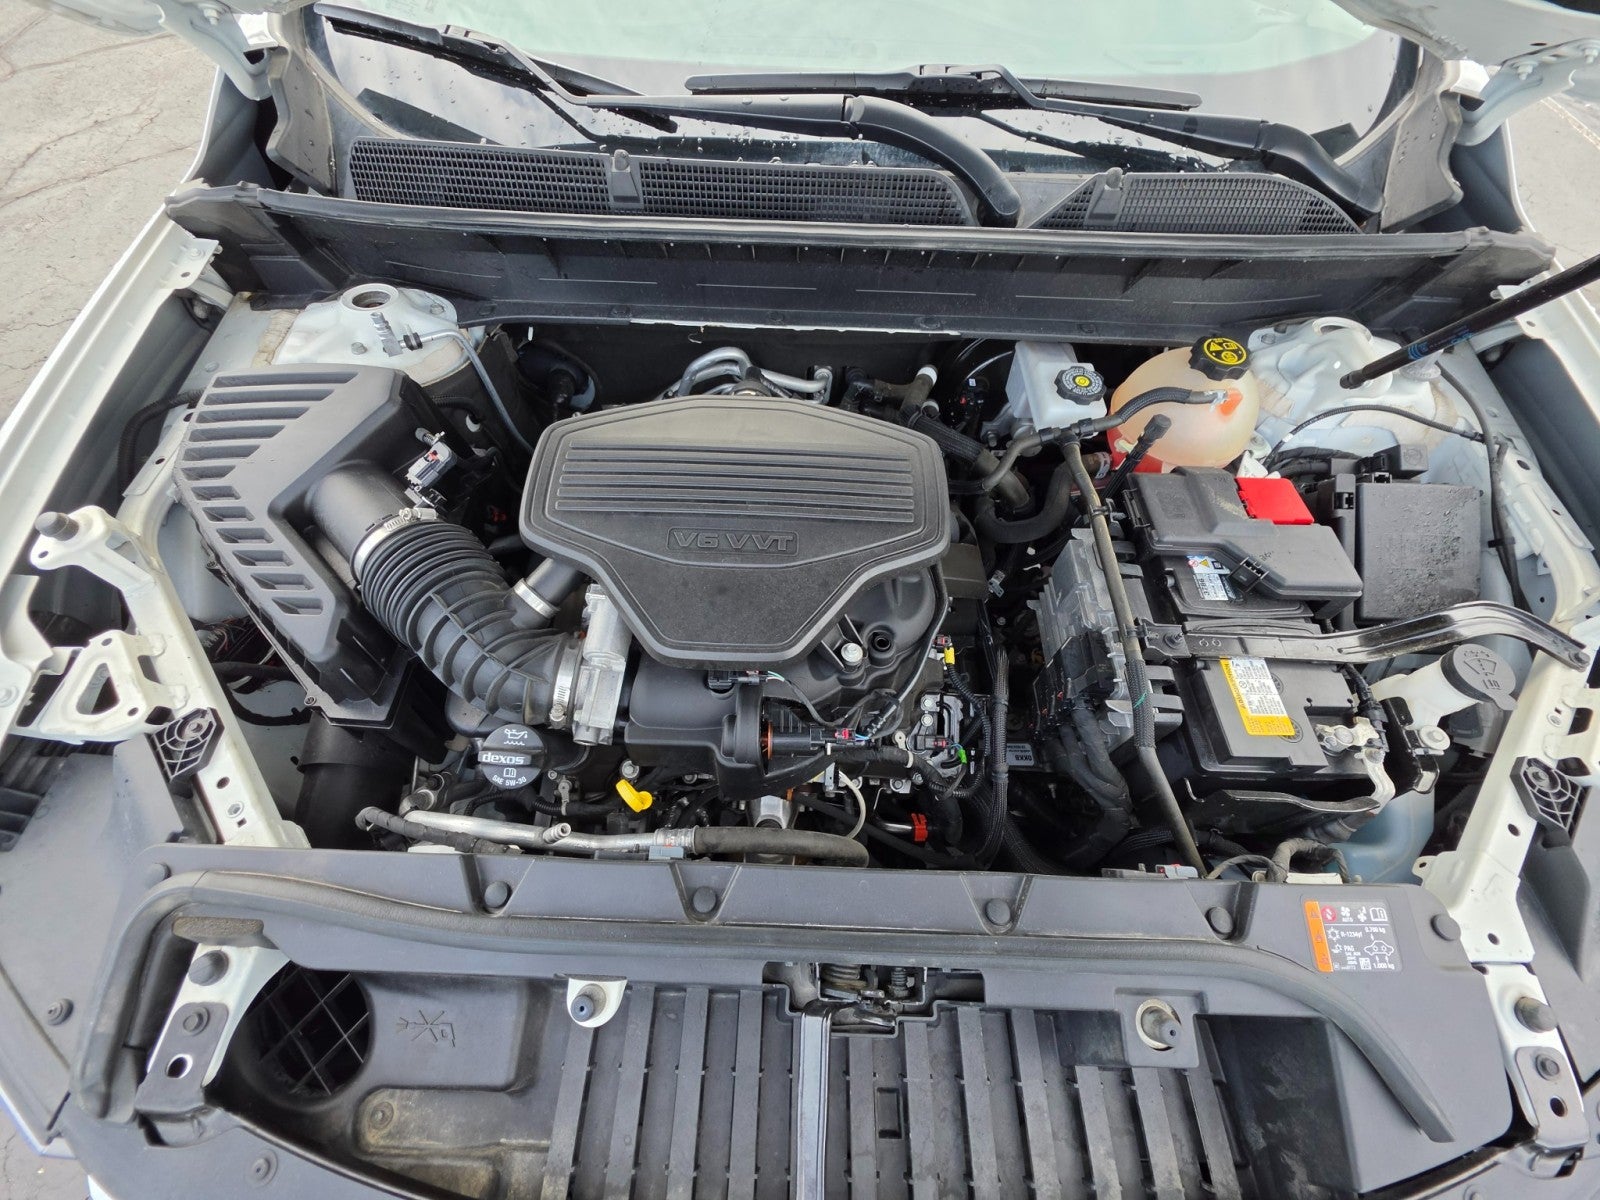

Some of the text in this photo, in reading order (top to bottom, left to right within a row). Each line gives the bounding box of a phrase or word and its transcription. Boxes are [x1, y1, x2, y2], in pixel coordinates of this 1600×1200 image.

[673, 531, 794, 551] V6 VVT
[482, 752, 526, 765] dexos
[492, 774, 527, 786] SAE 5W-30
